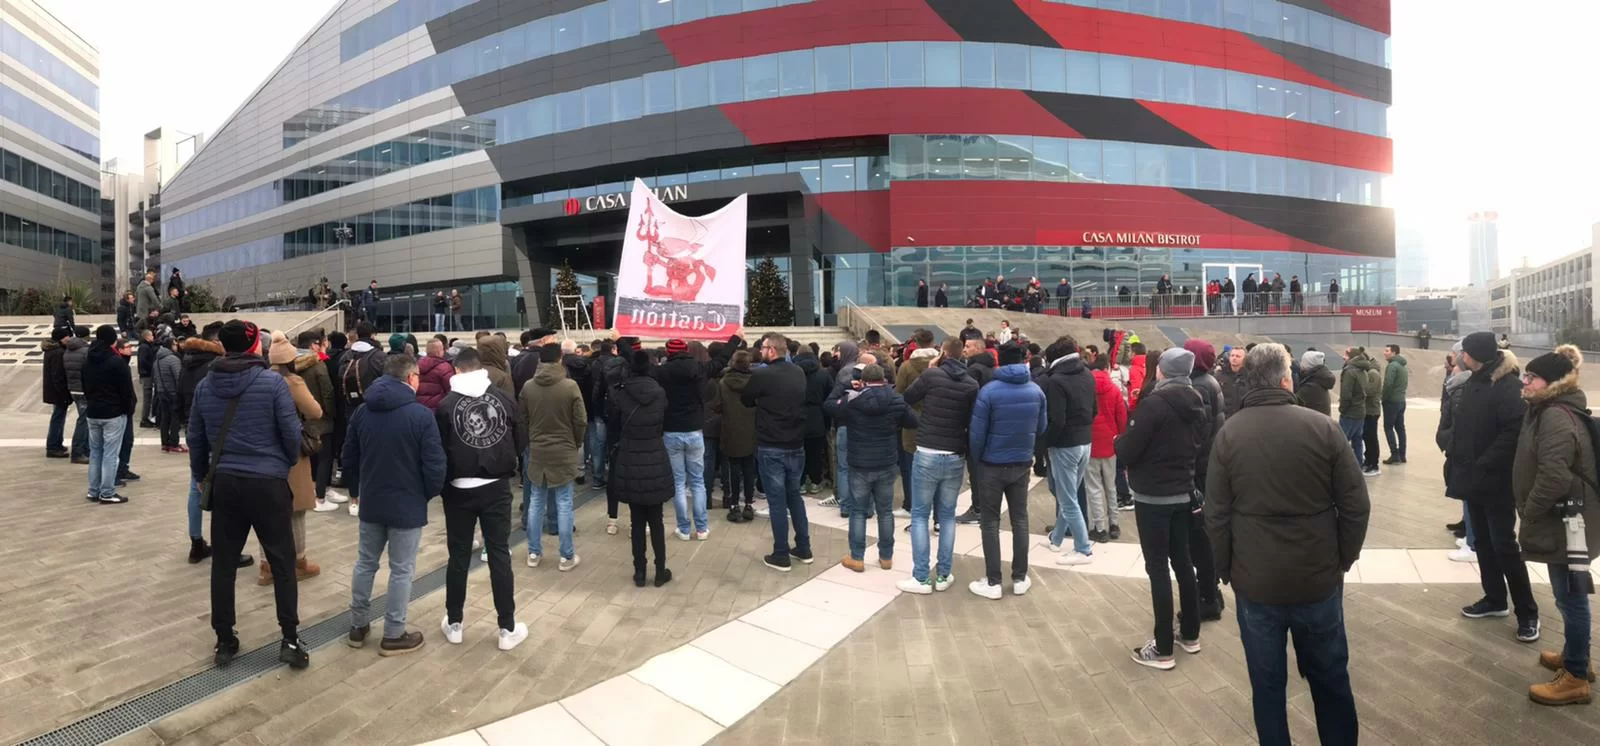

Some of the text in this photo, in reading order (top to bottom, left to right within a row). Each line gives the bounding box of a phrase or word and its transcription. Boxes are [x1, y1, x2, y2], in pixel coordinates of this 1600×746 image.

[586, 185, 687, 211] CASA LAN
[1082, 231, 1200, 246] CASA MILAN BISTROT
